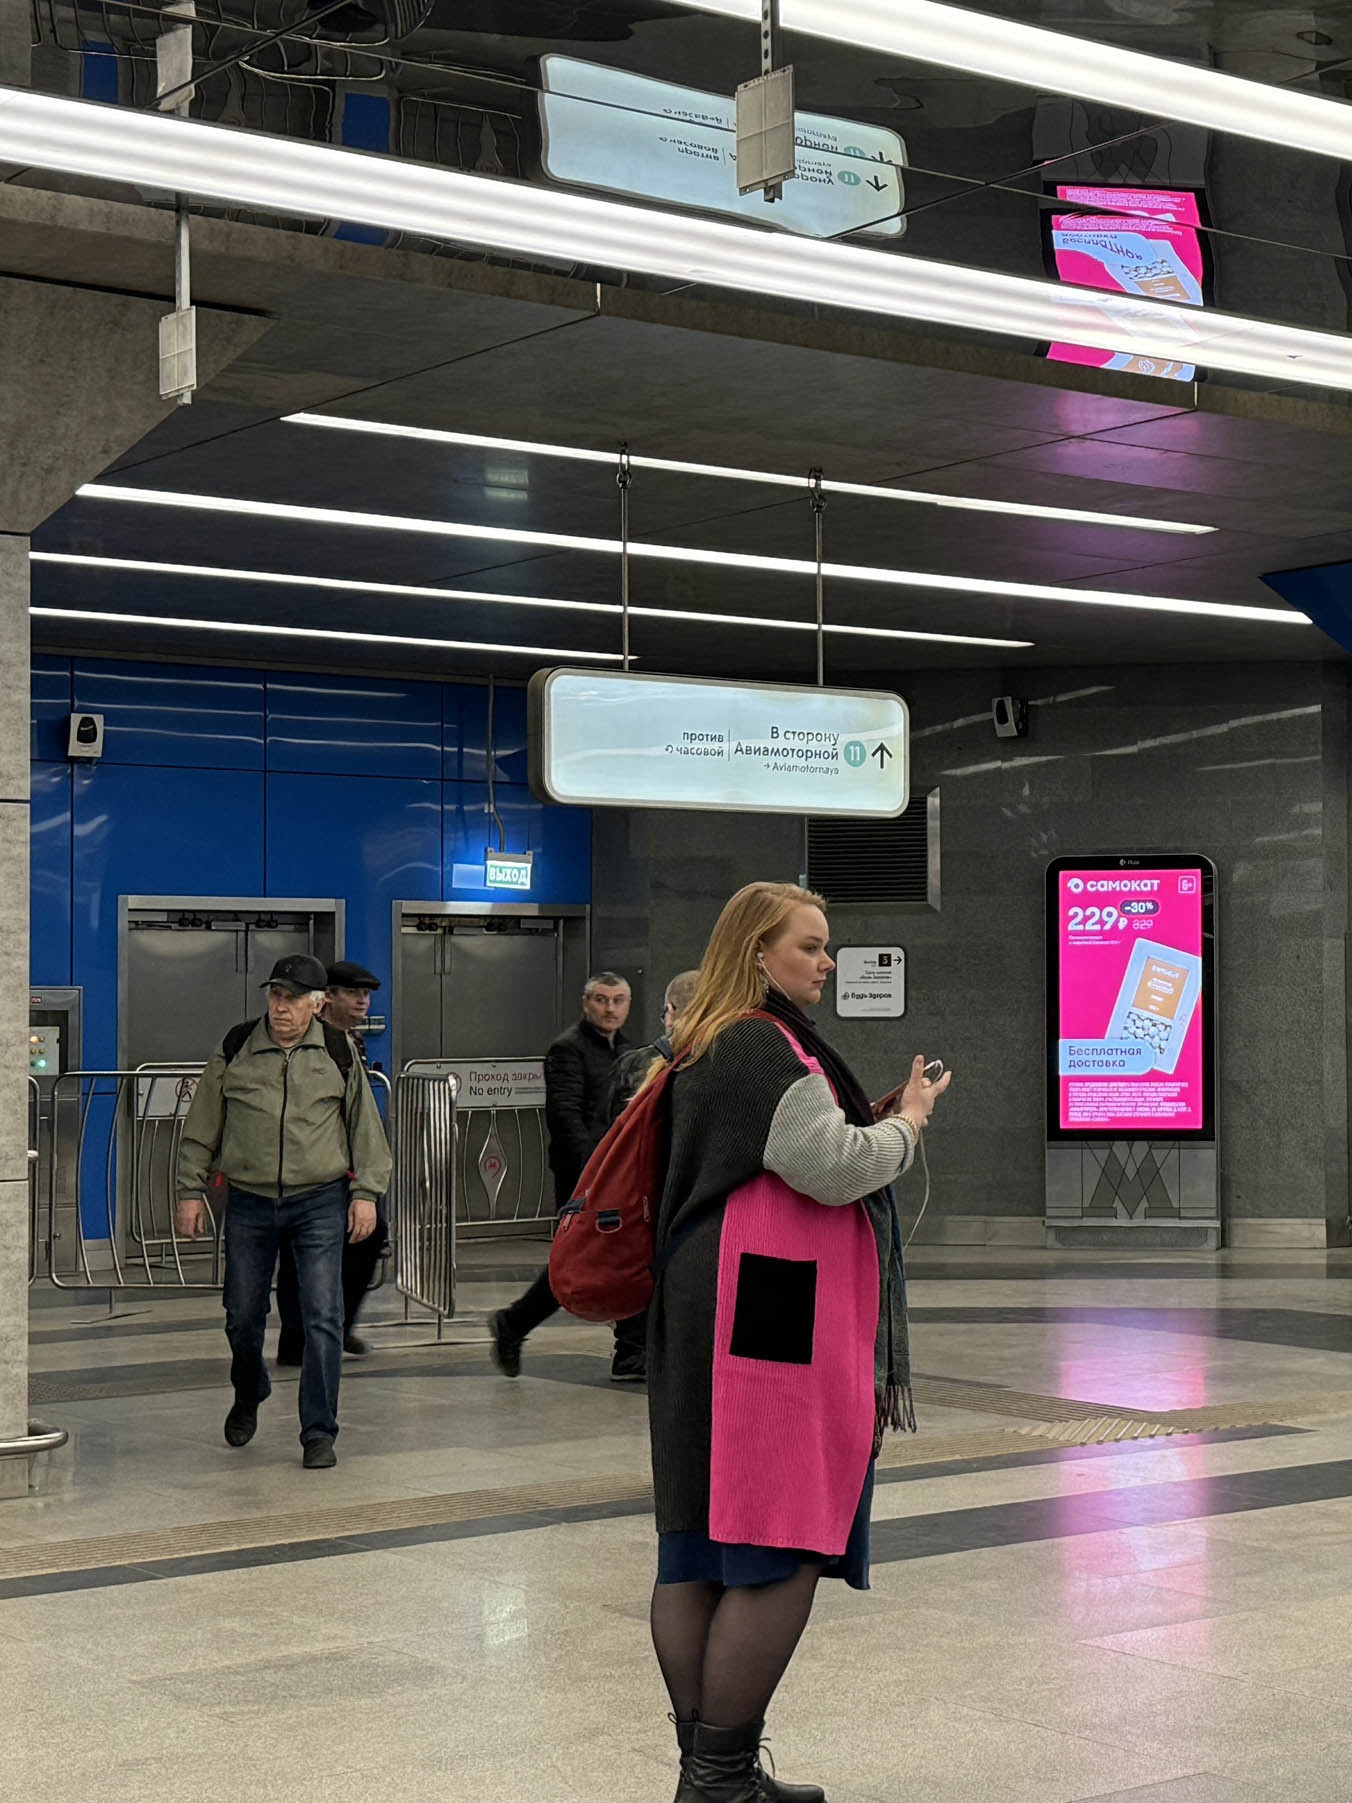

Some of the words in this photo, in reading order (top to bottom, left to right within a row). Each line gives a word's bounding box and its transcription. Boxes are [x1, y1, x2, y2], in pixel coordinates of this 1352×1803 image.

[682, 731, 724, 743] против
[770, 726, 780, 739] В
[783, 729, 840, 745] сторону
[676, 744, 724, 757] часовой
[734, 742, 839, 761] Авиамоторной
[849, 745, 861, 761] 11
[489, 867, 528, 884] ВЫХОД
[1086, 879, 1161, 892] самокат
[1181, 879, 1193, 891] 6+
[1068, 1045, 1142, 1056] Бесплатная
[1068, 1058, 1126, 1069] доставка
[469, 1071, 509, 1083] Проход
[469, 1086, 484, 1096] No
[486, 1085, 513, 1098] entry
